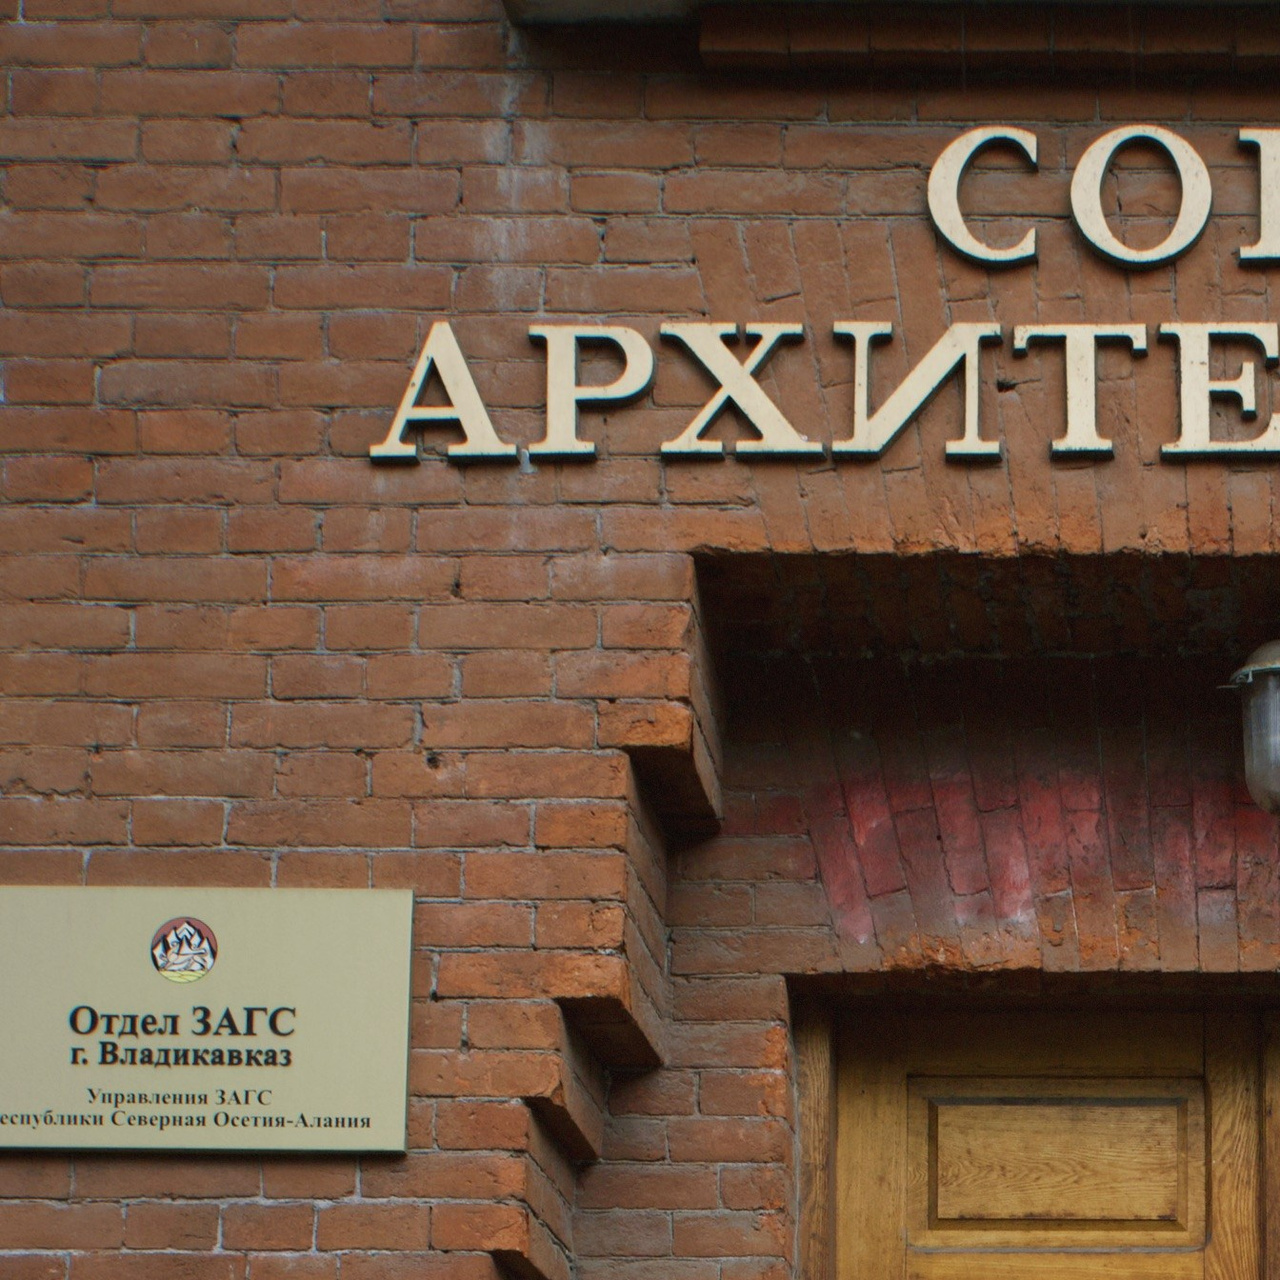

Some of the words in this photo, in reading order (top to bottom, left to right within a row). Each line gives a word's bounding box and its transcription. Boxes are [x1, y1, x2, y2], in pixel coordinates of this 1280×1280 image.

[69, 1005, 180, 1038] Отдел
[191, 1005, 296, 1037] ЗАГС
[70, 1047, 89, 1066] г.
[98, 1041, 292, 1068] Владикавказ
[87, 1088, 208, 1109] Управления
[215, 1088, 272, 1106] ЗАГС
[0, 1110, 104, 1130] еспублики
[110, 1110, 206, 1131] Северная
[213, 1111, 371, 1129] Осетия-Алания
